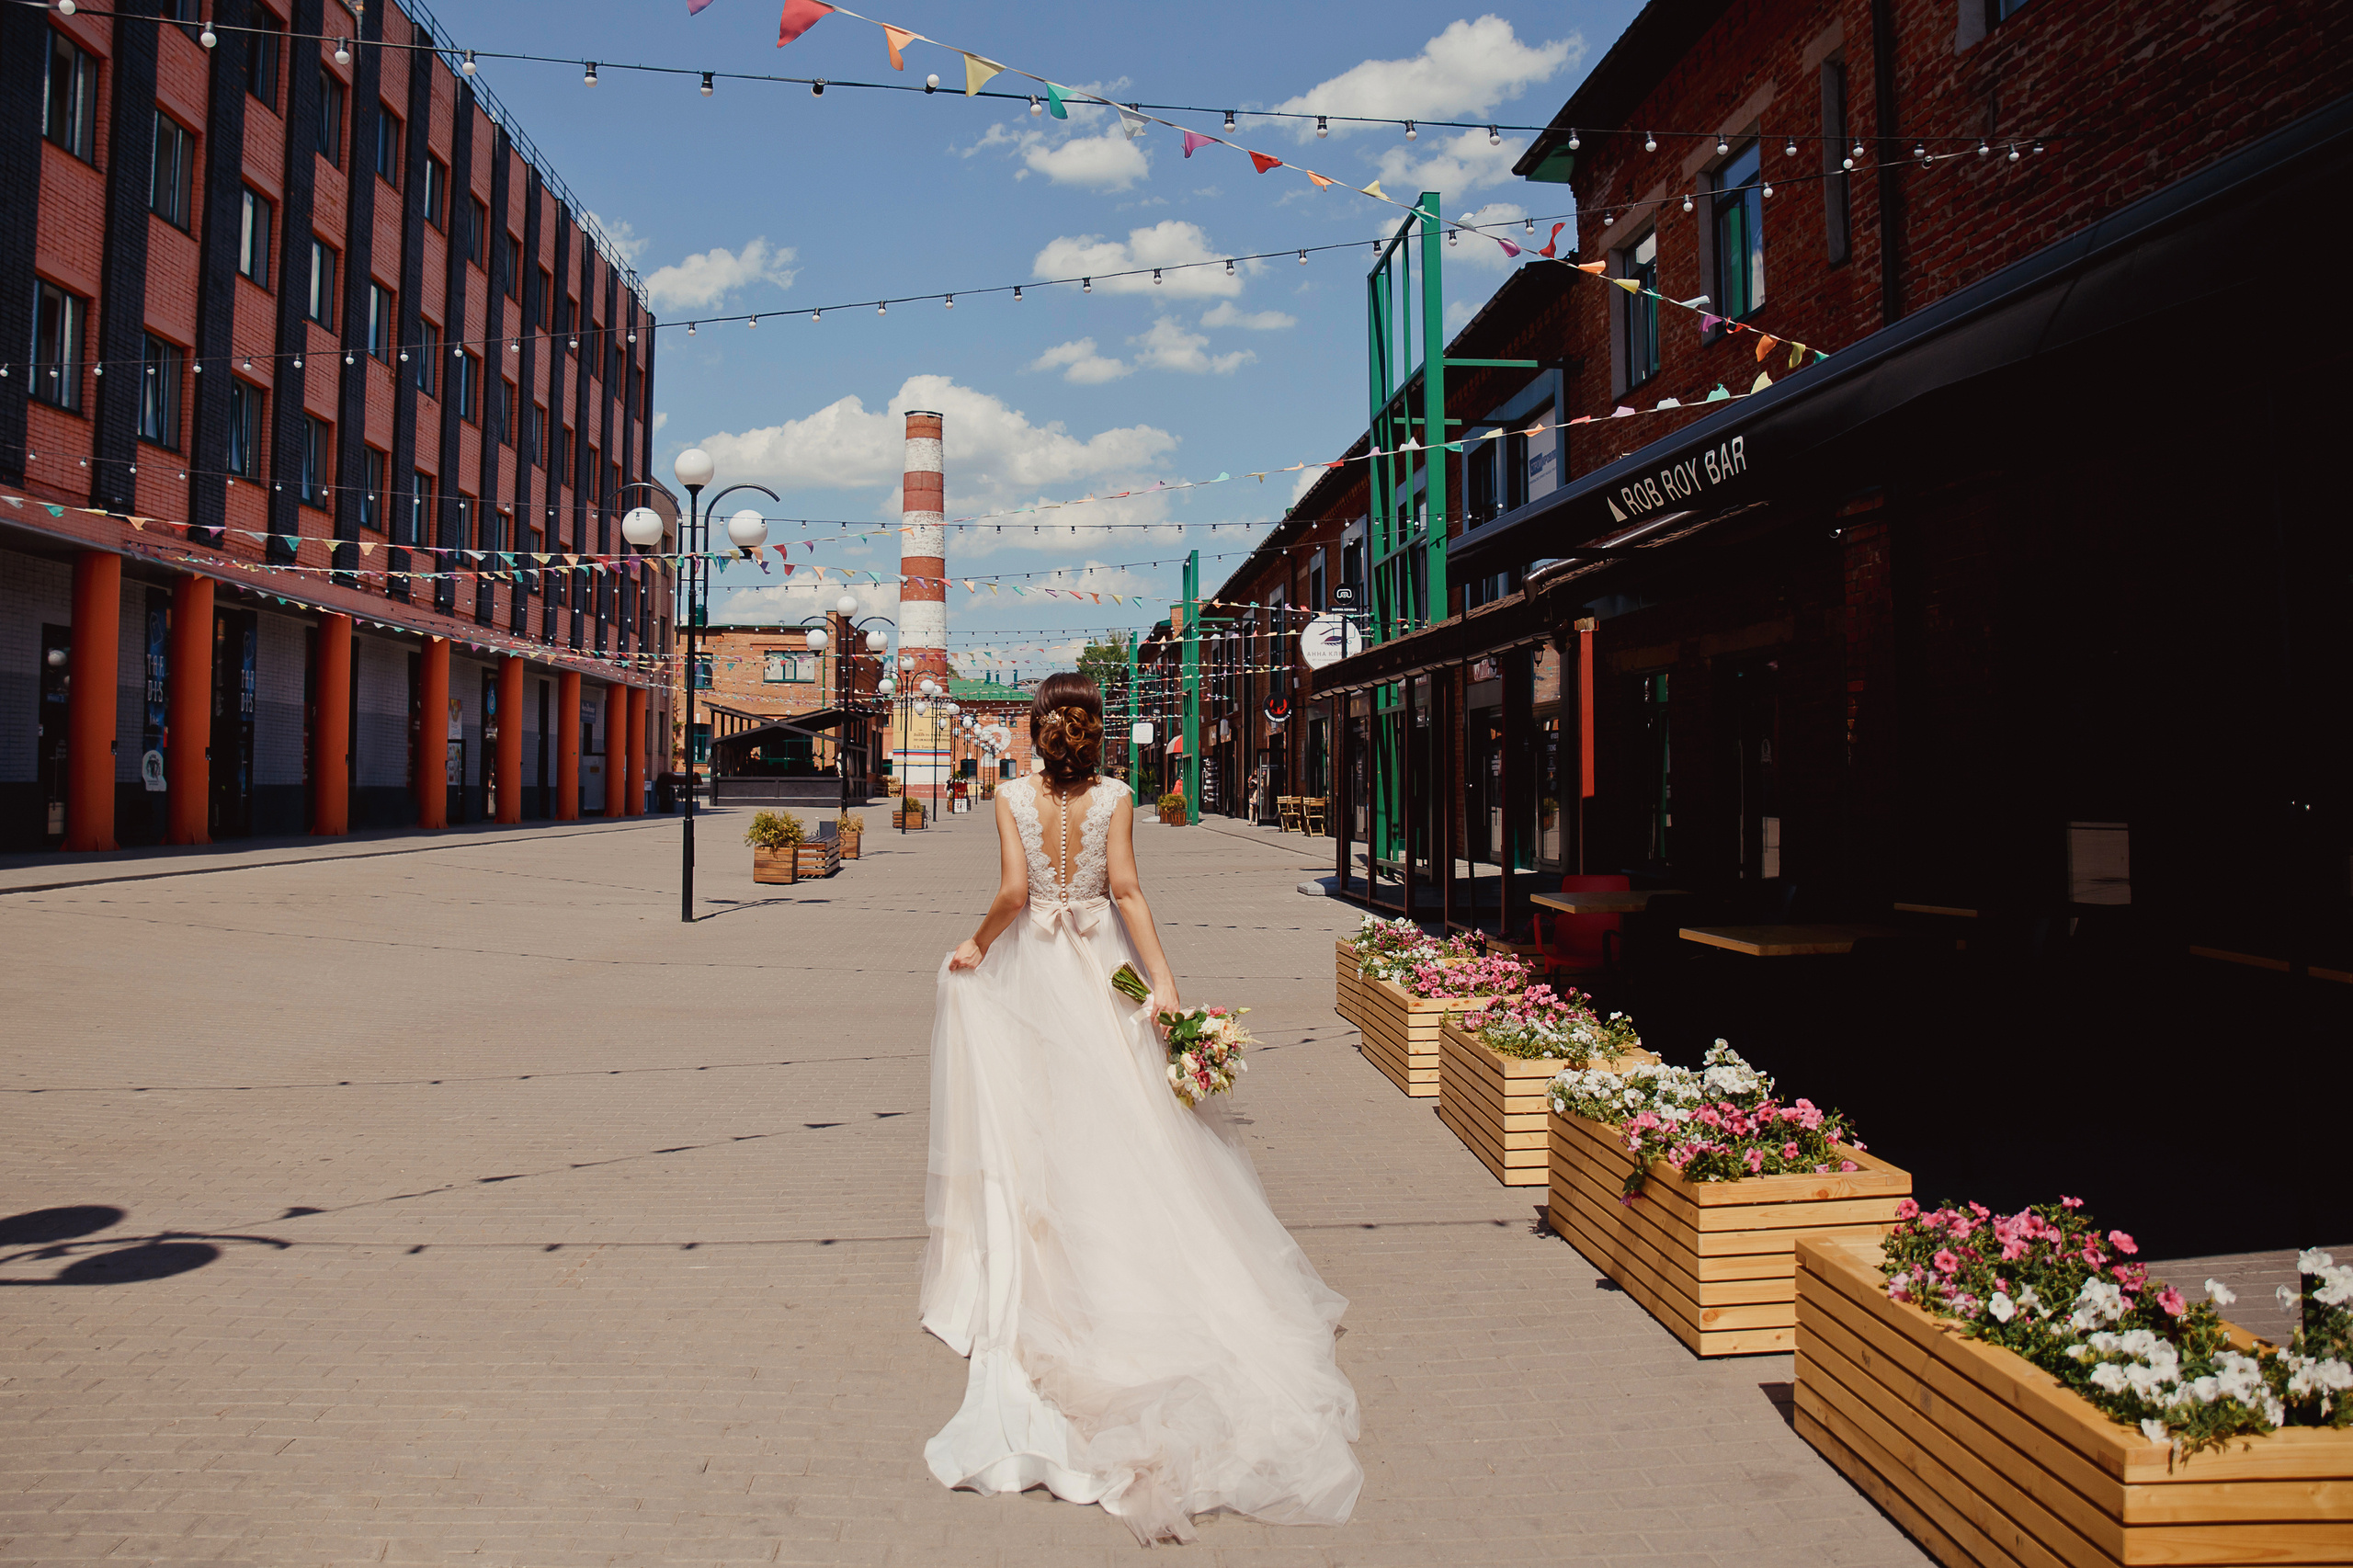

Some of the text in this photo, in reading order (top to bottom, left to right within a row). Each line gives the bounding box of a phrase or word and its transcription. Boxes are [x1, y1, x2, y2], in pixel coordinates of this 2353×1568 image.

[1620, 436, 1747, 516] ROB ROY BAR
